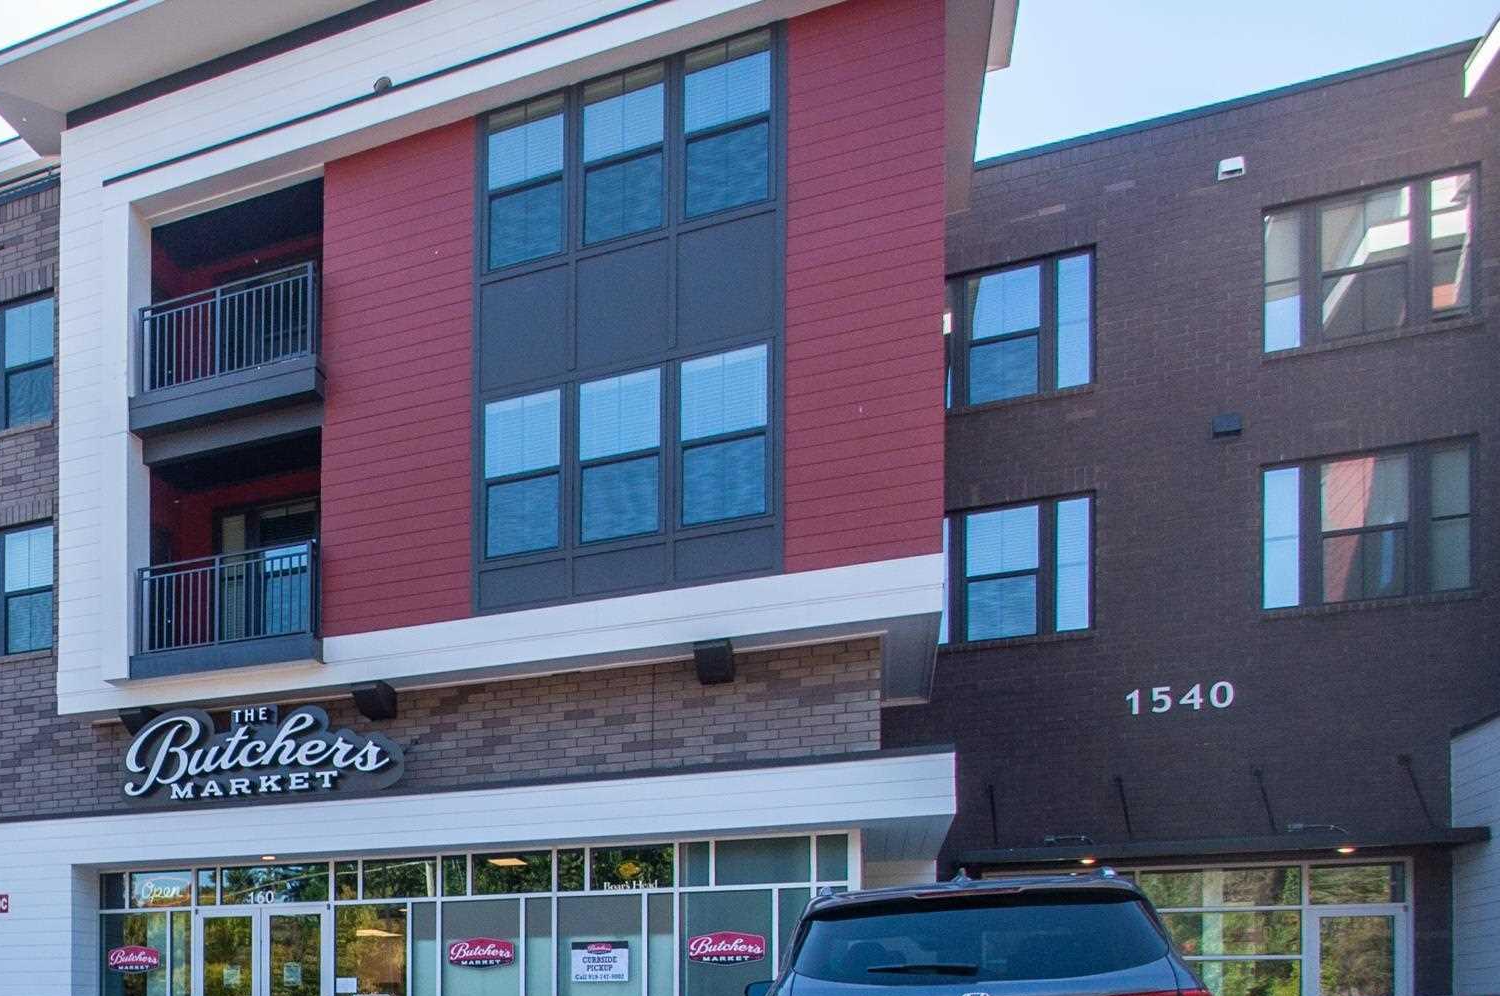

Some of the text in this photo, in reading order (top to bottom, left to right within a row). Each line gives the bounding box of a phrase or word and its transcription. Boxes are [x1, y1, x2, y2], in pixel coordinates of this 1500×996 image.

[1125, 681, 1235, 715] 1540
[232, 706, 268, 723] THE
[170, 770, 338, 799] MARKET
[141, 881, 184, 904] Open
[632, 880, 658, 889] Head
[248, 890, 275, 904] 160
